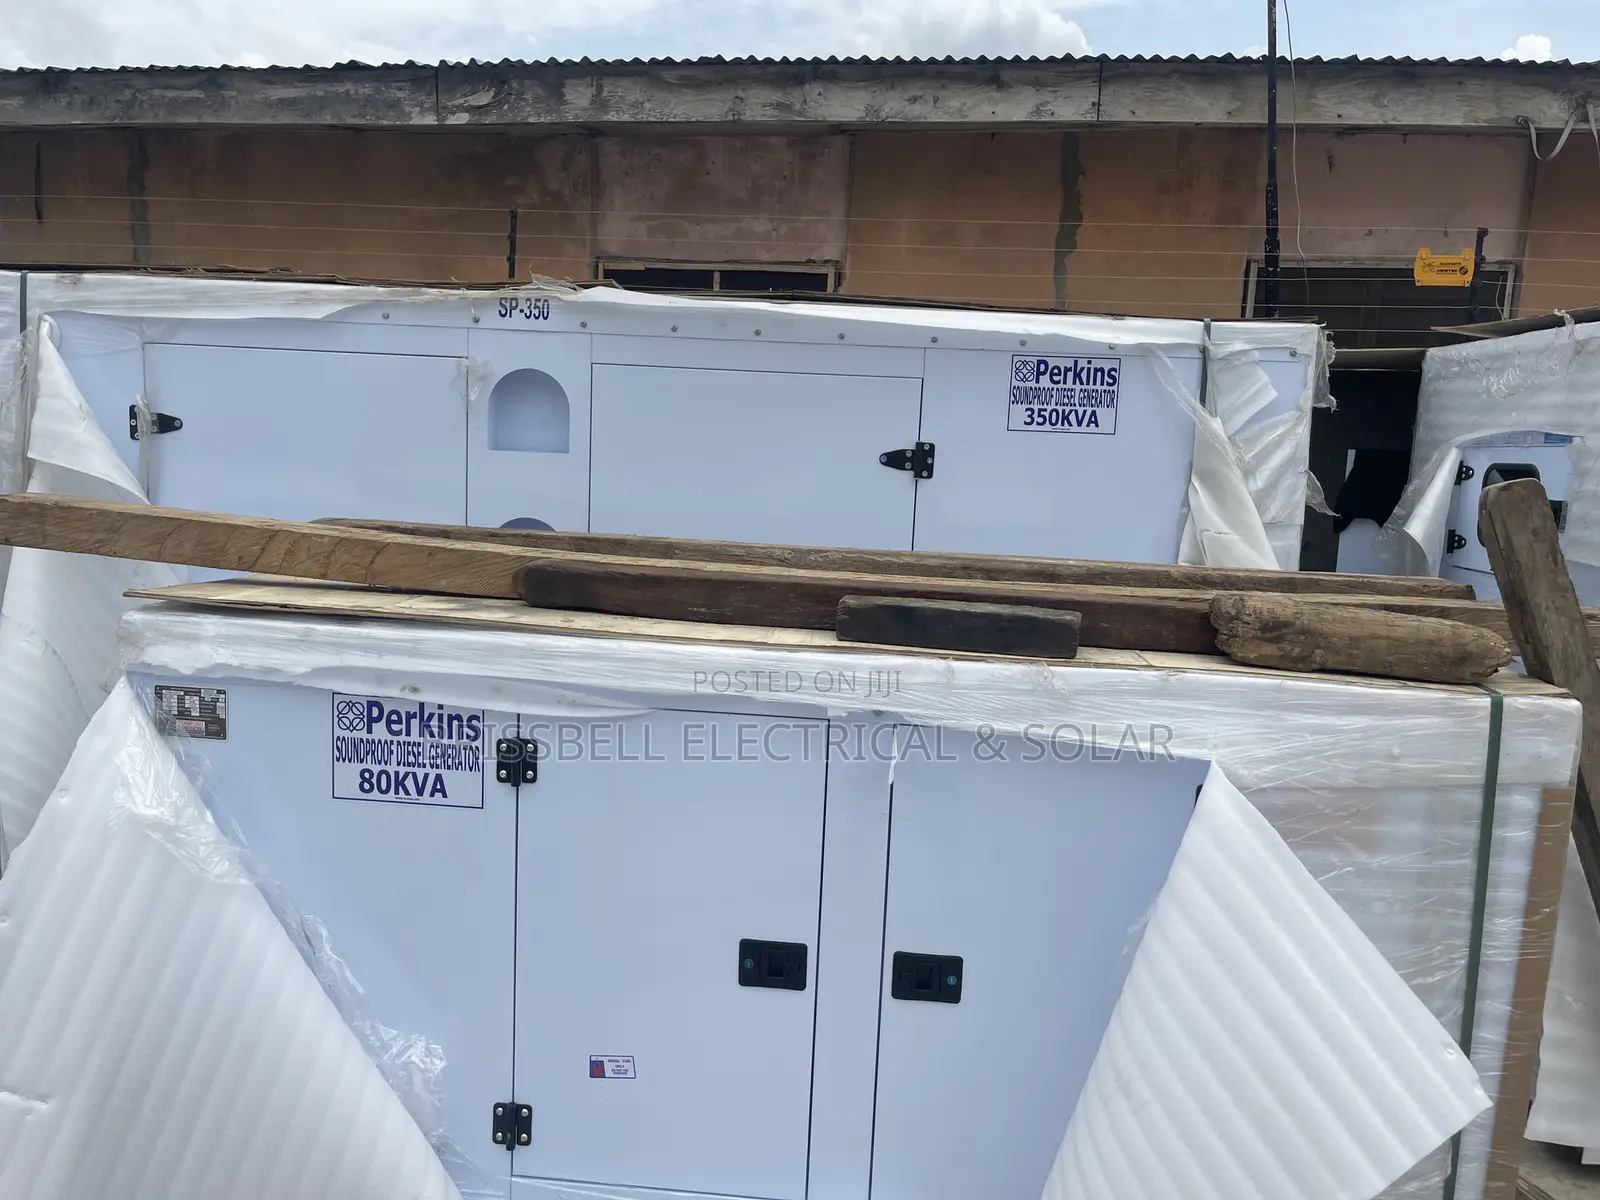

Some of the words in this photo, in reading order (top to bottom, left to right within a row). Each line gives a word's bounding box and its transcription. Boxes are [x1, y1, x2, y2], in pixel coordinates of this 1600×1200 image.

[498, 297, 550, 321] SP-350
[1034, 358, 1118, 387] Perkins
[1011, 385, 1055, 407] SOUNDPROOF
[1055, 387, 1077, 408] DIESEL
[1078, 388, 1116, 409] GENERATOR
[1023, 407, 1100, 428] 350KVA
[366, 700, 482, 742] Perkins
[335, 735, 395, 767] SOUNDPROOF
[396, 741, 427, 769] DIESEL
[428, 743, 481, 773] GENERATOR
[358, 768, 448, 799] 80KVA
